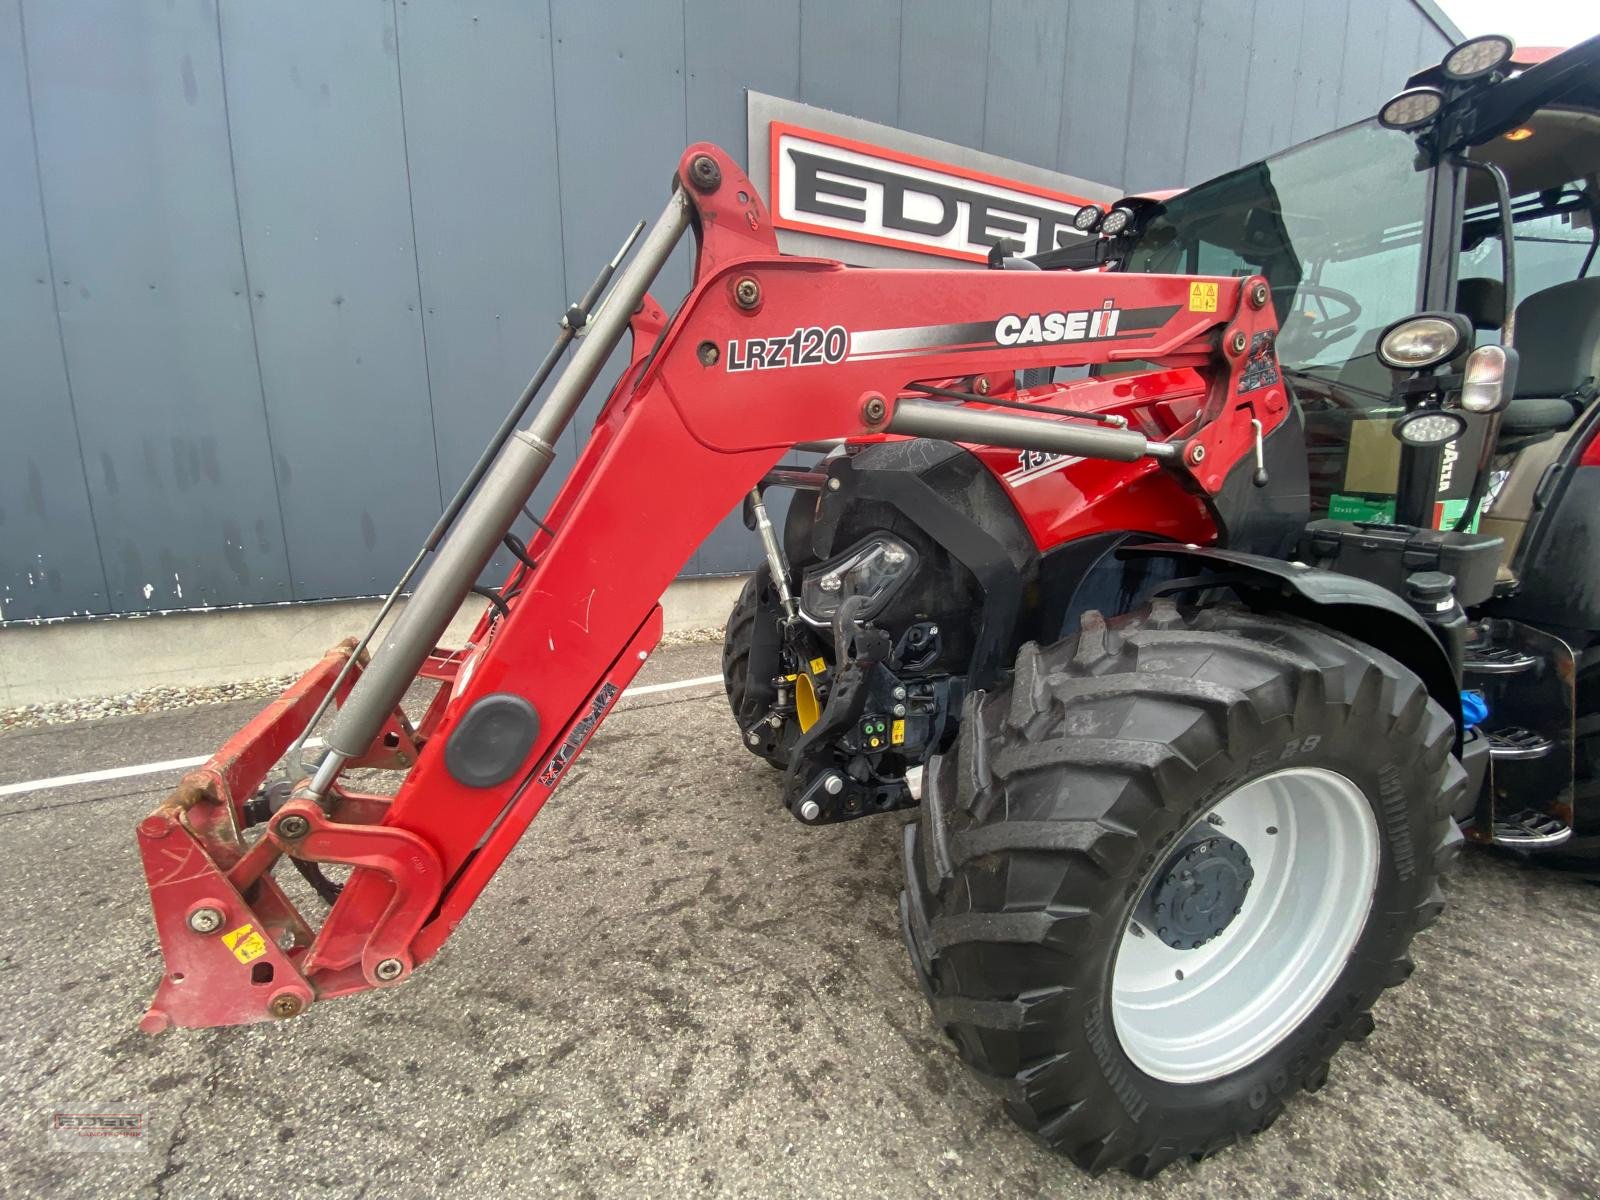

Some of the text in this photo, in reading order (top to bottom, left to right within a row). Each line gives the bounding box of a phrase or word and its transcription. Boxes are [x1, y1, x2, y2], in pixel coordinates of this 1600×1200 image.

[726, 325, 851, 372] LRZ120
[995, 310, 1089, 346] CASE
[1439, 440, 1459, 493] VAZZA
